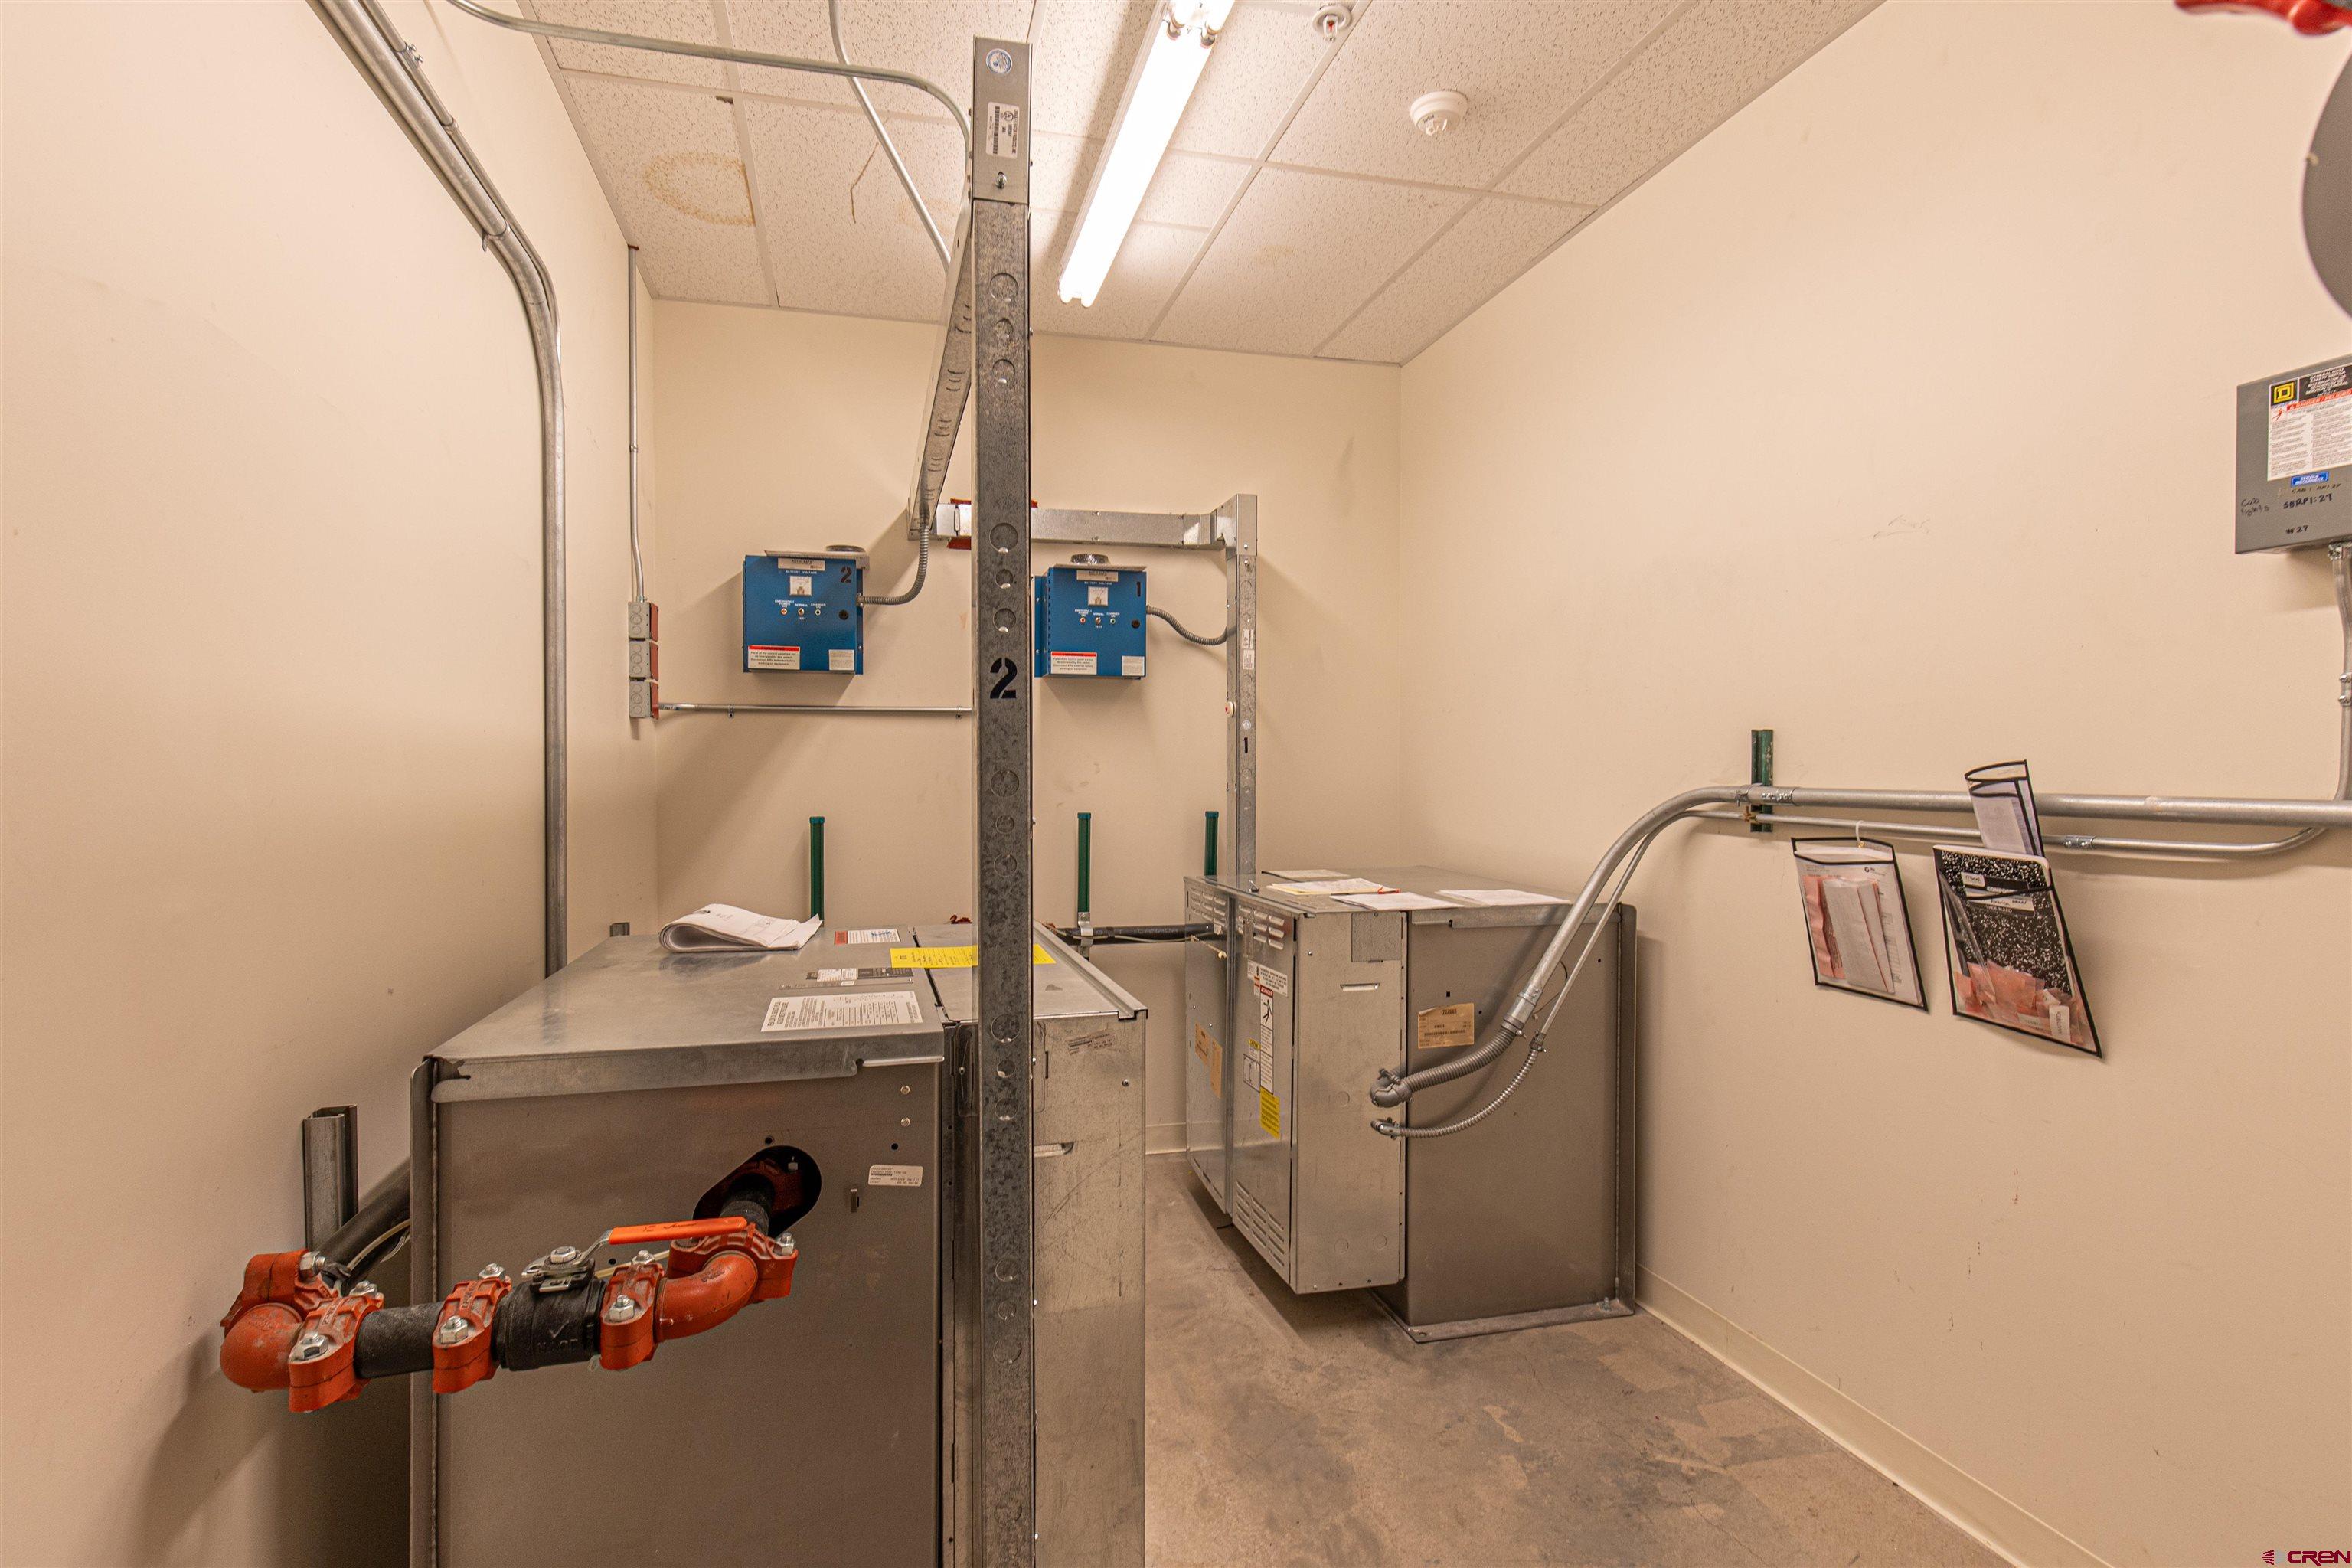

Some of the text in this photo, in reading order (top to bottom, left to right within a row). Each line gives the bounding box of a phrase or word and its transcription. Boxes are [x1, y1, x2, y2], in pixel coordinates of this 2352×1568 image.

[840, 566, 852, 583] 2
[1136, 581, 1142, 597] 1
[990, 657, 1018, 699] 2
